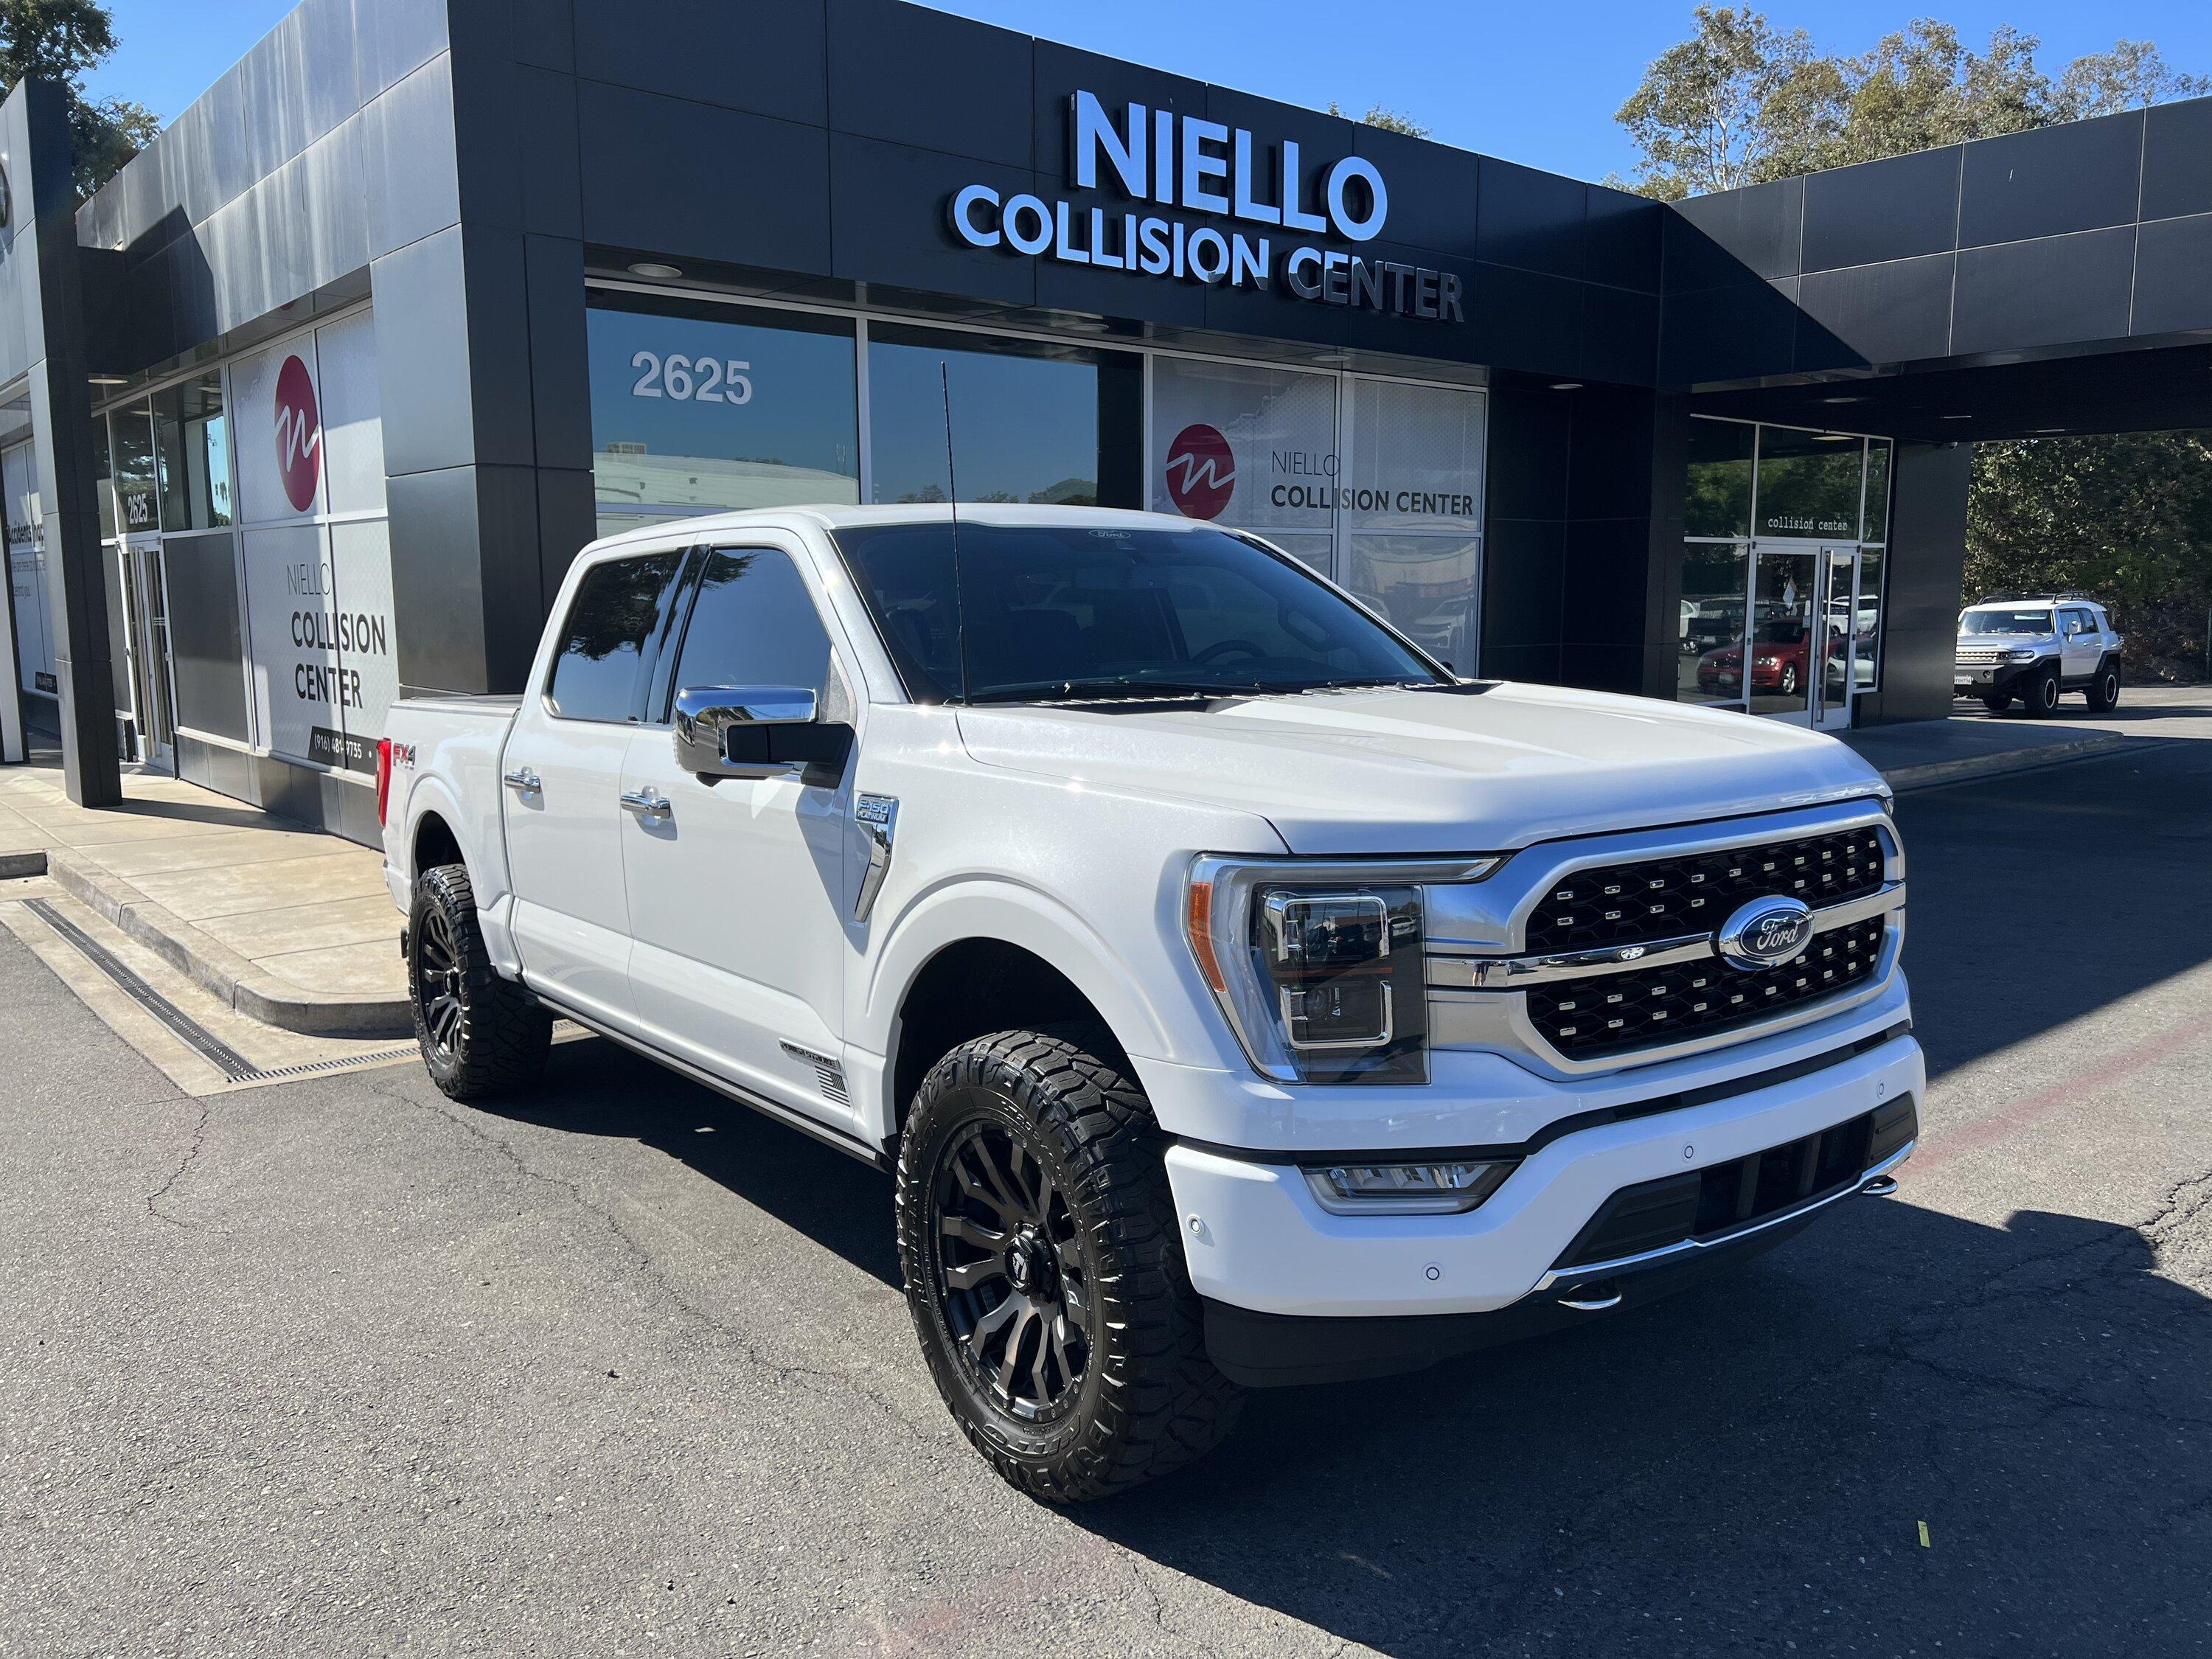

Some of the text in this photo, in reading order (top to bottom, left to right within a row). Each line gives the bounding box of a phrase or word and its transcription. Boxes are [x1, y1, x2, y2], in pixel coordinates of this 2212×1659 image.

[1076, 89, 1388, 242] NIELLO
[953, 184, 1464, 323] COLLISION CENTER
[631, 351, 752, 405] 2625
[1271, 450, 1340, 477] NIELLO
[128, 493, 148, 524] 2625
[1270, 484, 1473, 515] COLLISION CENTER
[1767, 516, 1848, 531] collision center
[287, 563, 331, 596] NIELLO
[291, 611, 386, 656] COLLISION
[295, 663, 364, 709] CENTER
[314, 733, 330, 753] (916)
[393, 742, 417, 767] FX4
[1756, 916, 1804, 950] Ford
